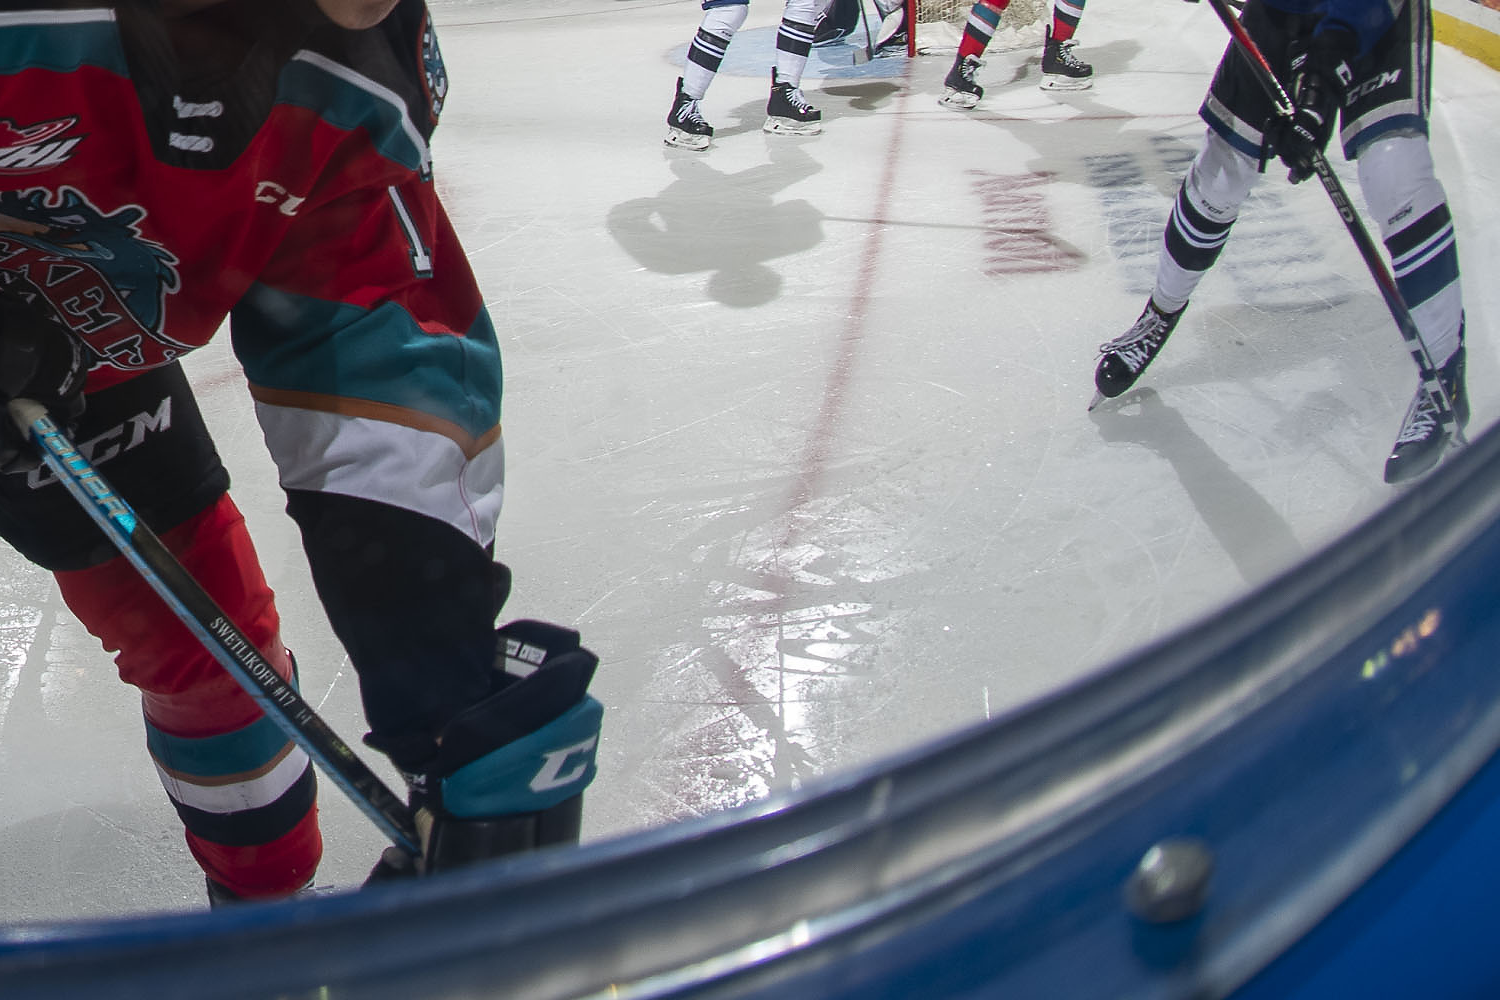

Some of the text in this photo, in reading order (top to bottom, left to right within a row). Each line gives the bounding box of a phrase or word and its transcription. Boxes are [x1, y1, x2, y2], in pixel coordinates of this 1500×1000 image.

[1346, 67, 1404, 108] CCM
[1387, 205, 1413, 226] CCM
[210, 616, 297, 707] SWETLIKOFF #17
